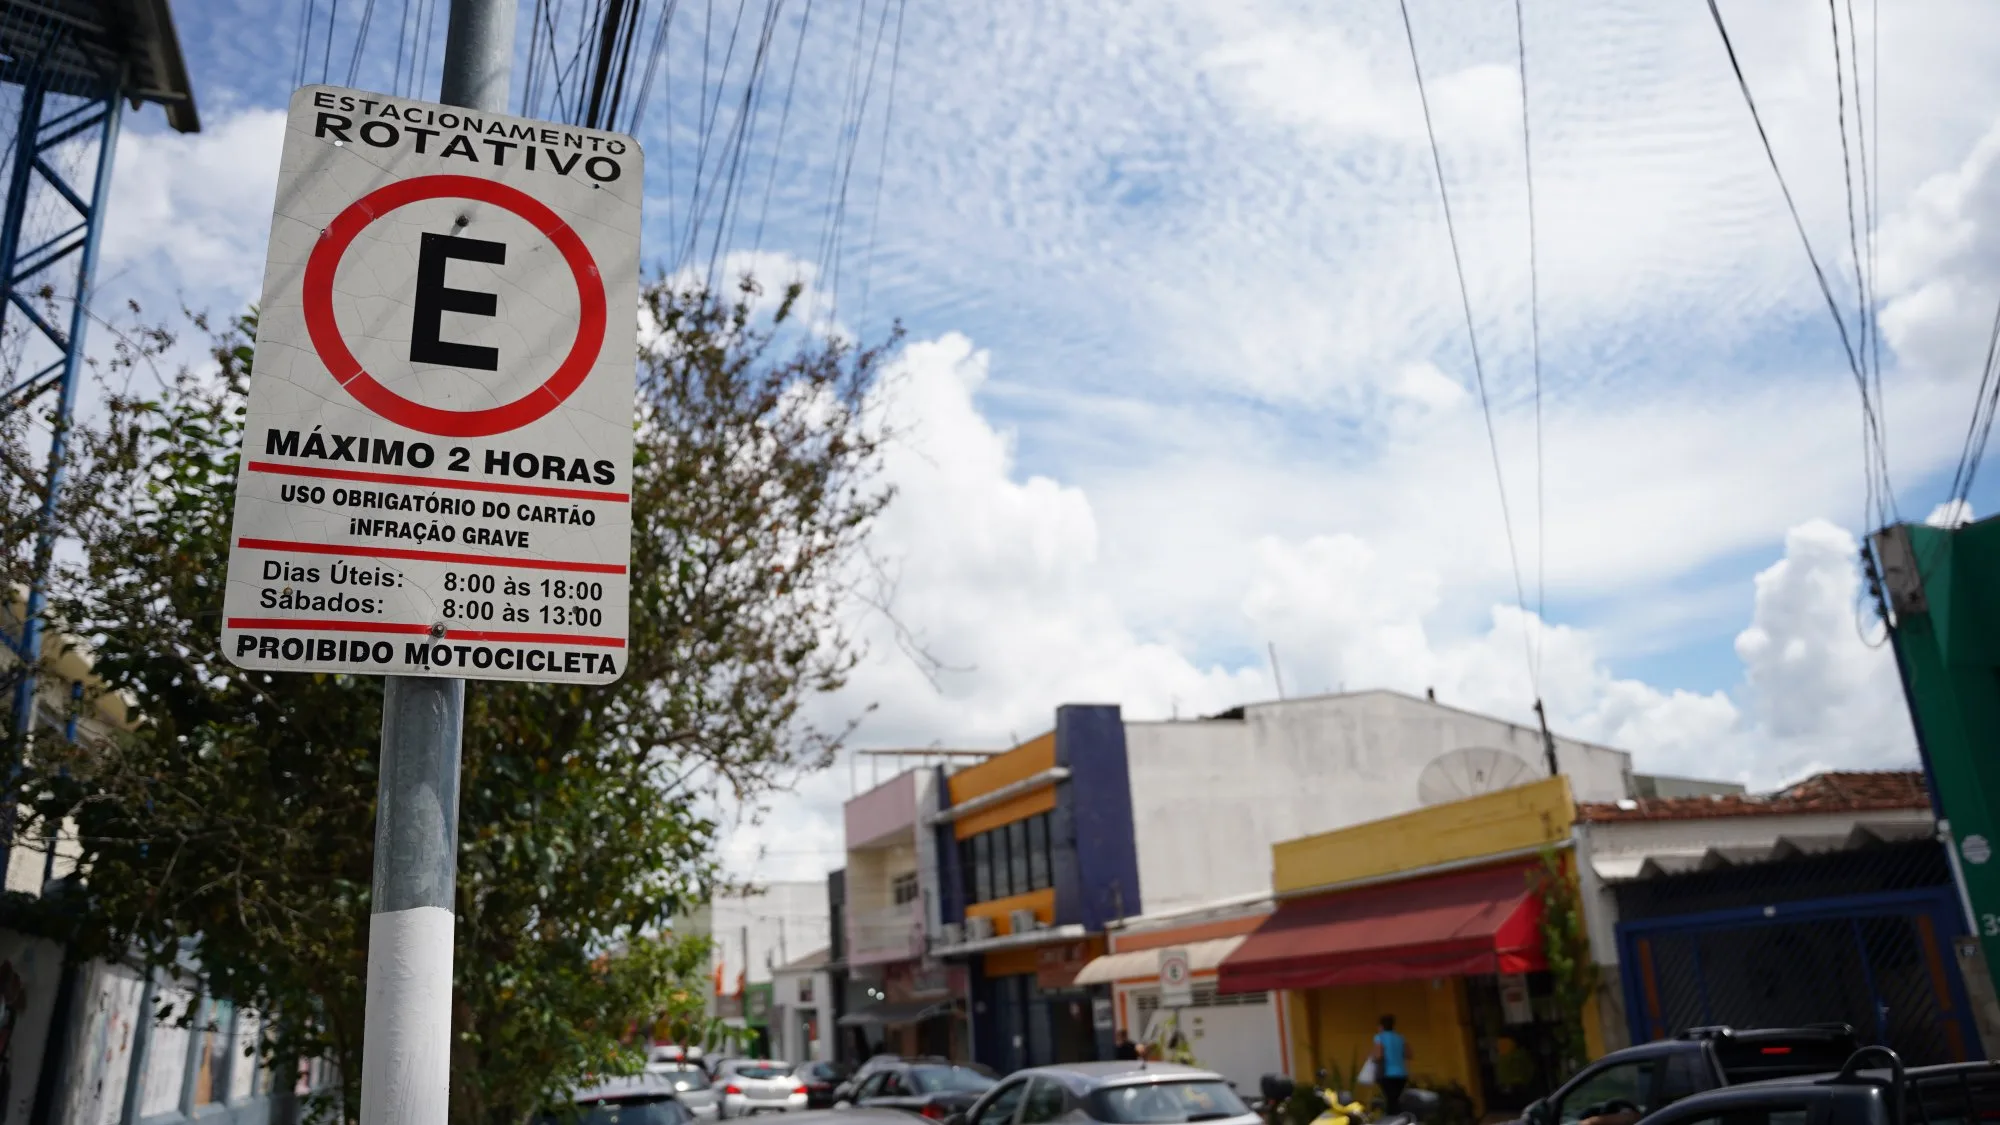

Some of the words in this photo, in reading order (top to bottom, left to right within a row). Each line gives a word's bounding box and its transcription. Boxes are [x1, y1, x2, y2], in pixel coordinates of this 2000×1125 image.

[314, 91, 627, 155] ESTACIONAMENTO
[314, 111, 622, 183] ROTATIVO
[409, 231, 507, 372] E
[265, 425, 435, 469] MÁXIMO
[447, 446, 471, 473] 2
[484, 449, 616, 486] HORAS
[280, 484, 326, 504] USO
[332, 489, 476, 517] OBRIGATÓRIO
[482, 501, 511, 520] DO
[516, 503, 596, 527] CARTÃO
[462, 526, 530, 549] GRAVE
[262, 560, 321, 584] Dias
[330, 559, 404, 588] Úteis:
[443, 571, 495, 594] 8:00
[503, 575, 531, 597] às
[540, 579, 603, 601] 18:00
[442, 598, 494, 621] 8:00
[502, 602, 530, 623] às
[539, 605, 602, 628] 13:00
[236, 634, 394, 664] PROIBIDO
[404, 642, 617, 675] MOTOCICLETA
